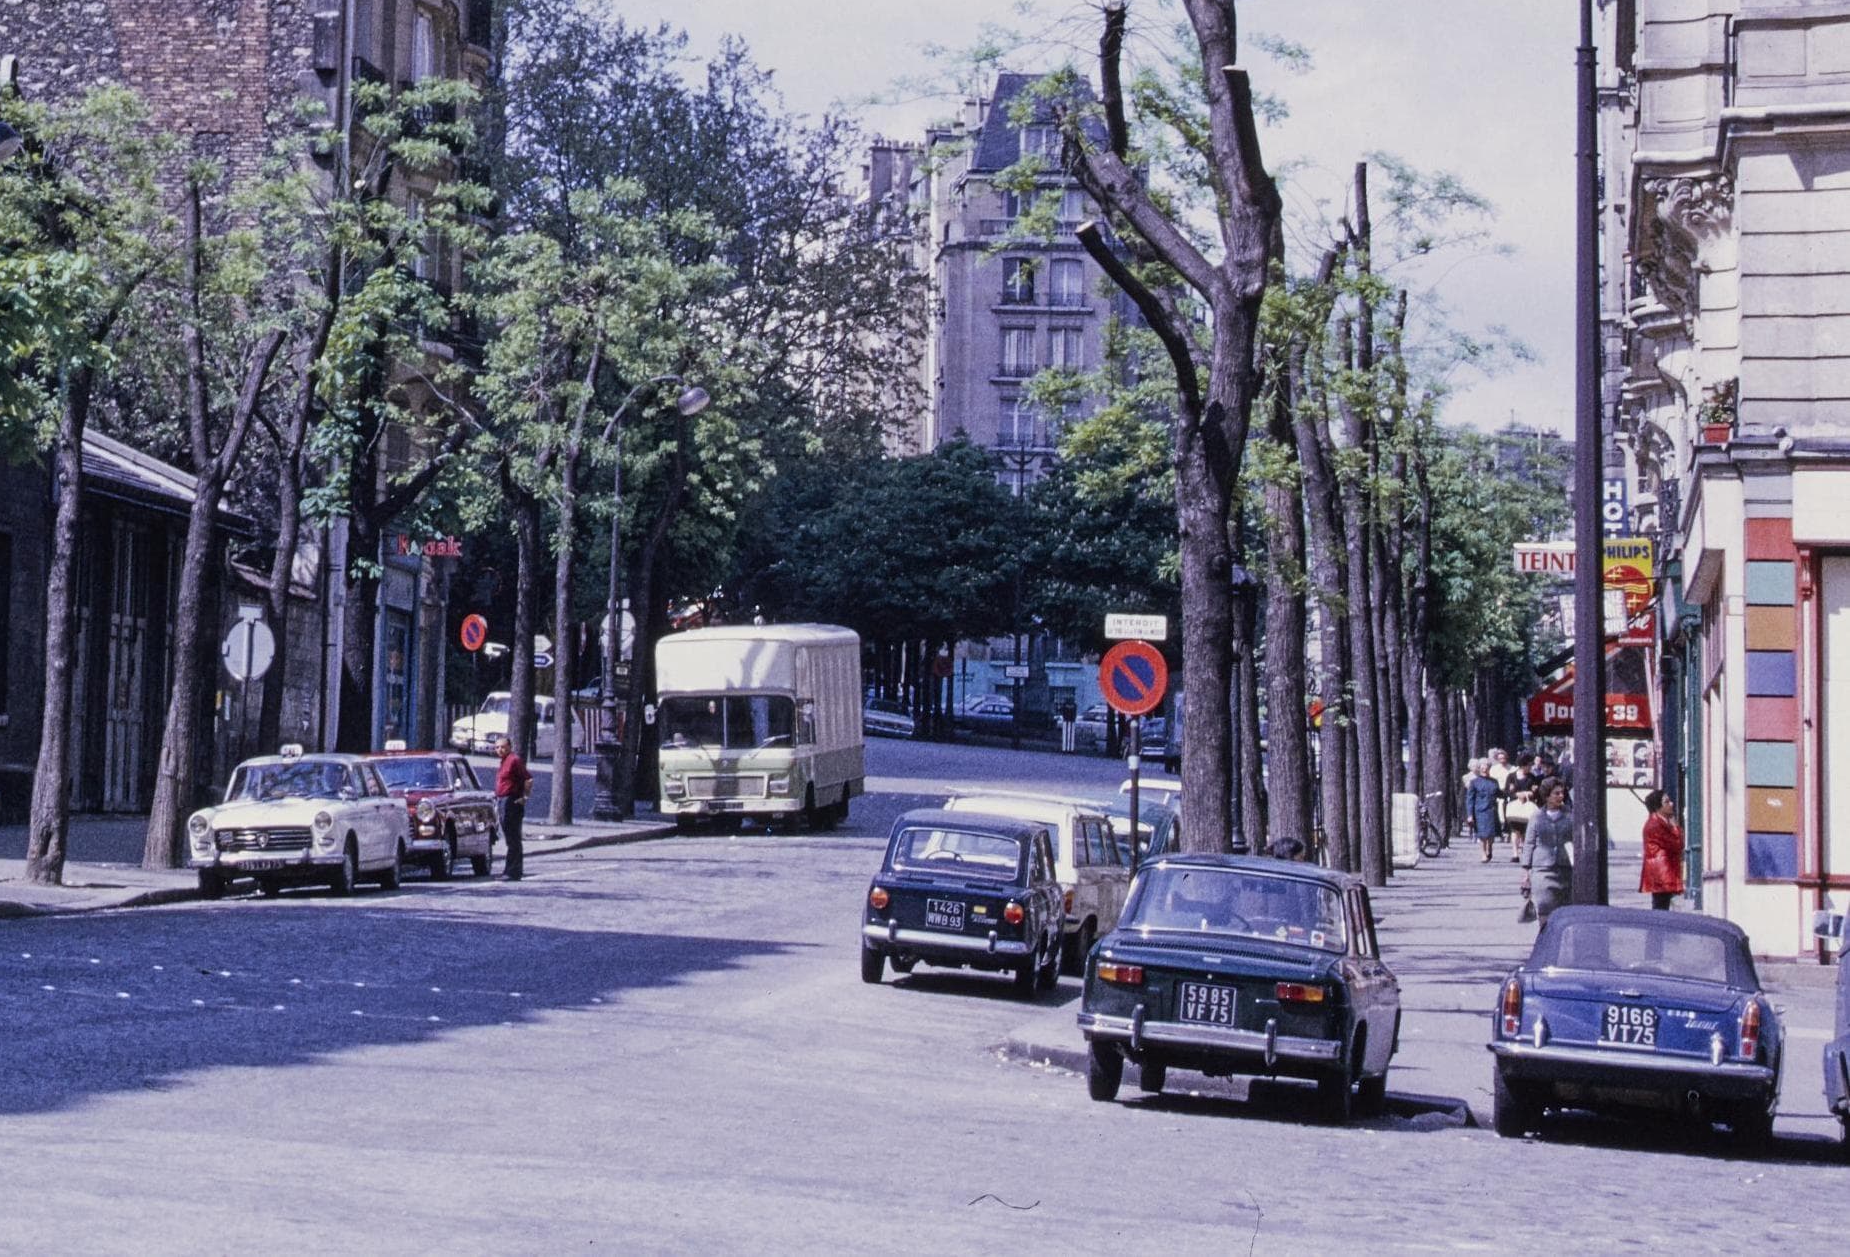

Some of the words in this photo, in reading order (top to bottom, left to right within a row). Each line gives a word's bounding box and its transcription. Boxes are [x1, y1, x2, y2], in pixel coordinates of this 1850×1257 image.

[398, 534, 463, 557] Kdak
[1604, 544, 1650, 559] HILIPS
[1112, 618, 1160, 628] INTERDIT
[933, 902, 960, 914] 1426
[1188, 986, 1230, 1005] 5985
[1187, 1002, 1206, 1019] VF
[1210, 1005, 1228, 1022] 75
[1608, 1006, 1654, 1026] 9166
